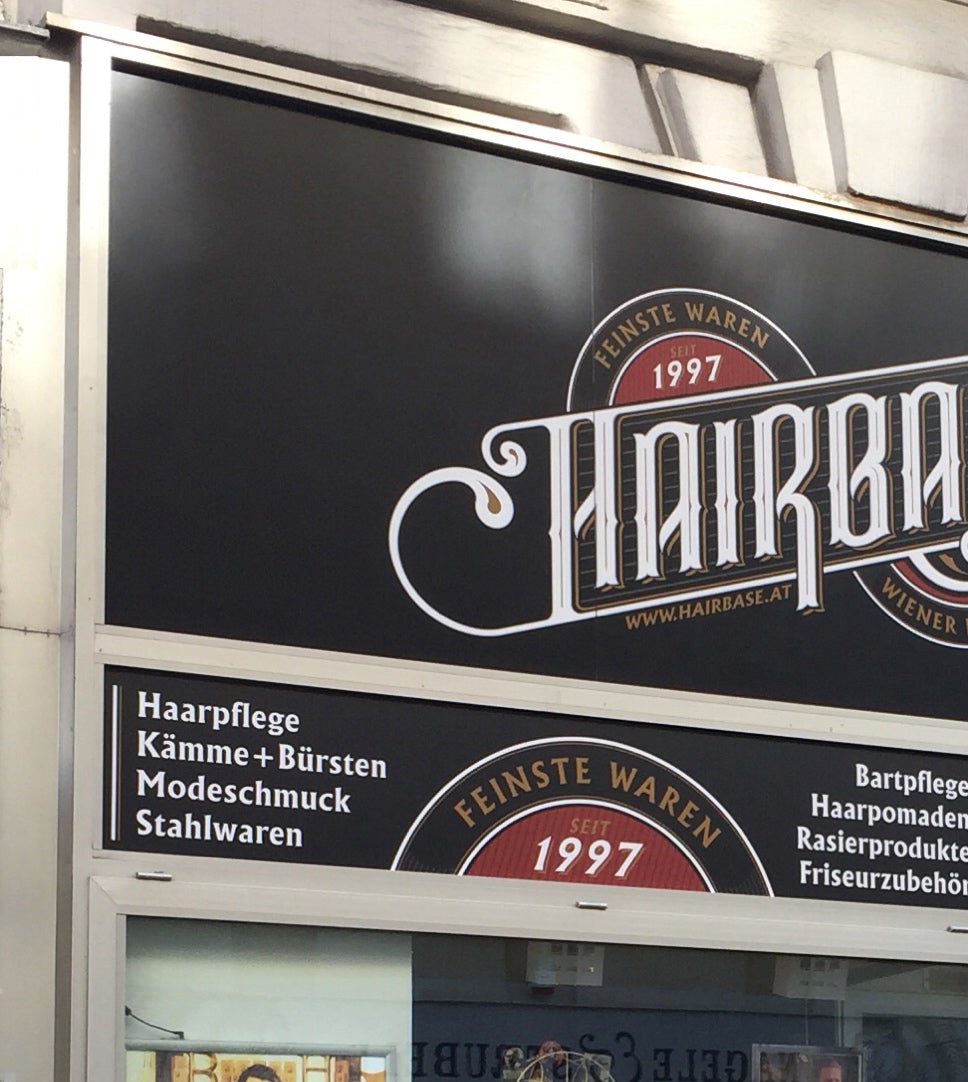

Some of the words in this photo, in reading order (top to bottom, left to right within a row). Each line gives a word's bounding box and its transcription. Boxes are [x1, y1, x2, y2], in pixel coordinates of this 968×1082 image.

[593, 303, 676, 369] FEINSTE
[684, 301, 770, 349] WAREN
[670, 344, 697, 358] SEIT
[653, 354, 722, 389] 1997
[624, 585, 792, 630] WWW.HAIRBASE.AT
[881, 576, 957, 634] WIENER
[138, 691, 300, 736] Haarpflege
[136, 769, 351, 814] Modeschmuck
[454, 757, 592, 828] FEINSTE
[610, 761, 722, 848] WAREN
[136, 809, 303, 847] Stahlwaren
[570, 817, 611, 836] SEIT
[534, 836, 644, 878] 1997
